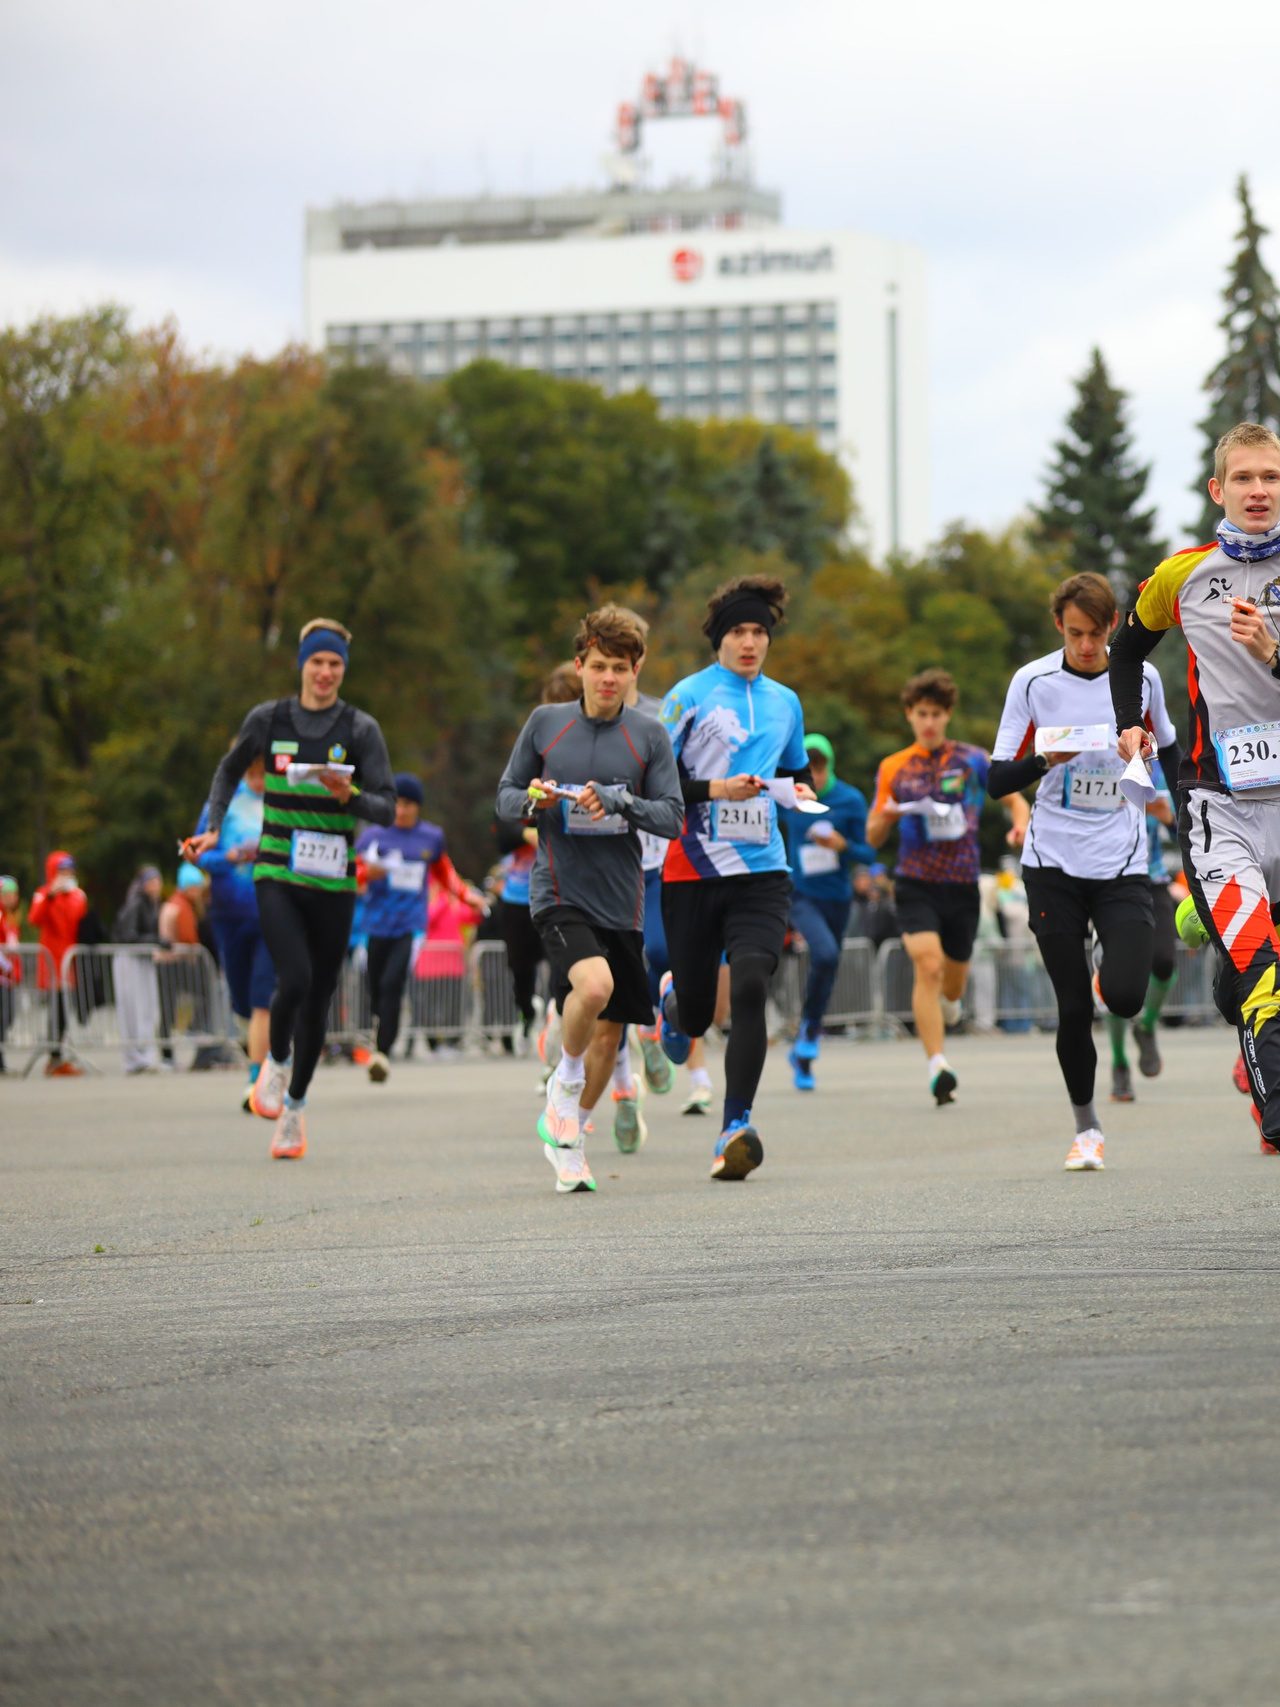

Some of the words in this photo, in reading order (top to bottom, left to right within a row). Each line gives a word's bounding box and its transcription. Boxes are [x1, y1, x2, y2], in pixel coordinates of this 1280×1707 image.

[1073, 780, 1117, 796] 217.1
[721, 809, 761, 824] 231.1
[298, 842, 338, 860] 227.1
